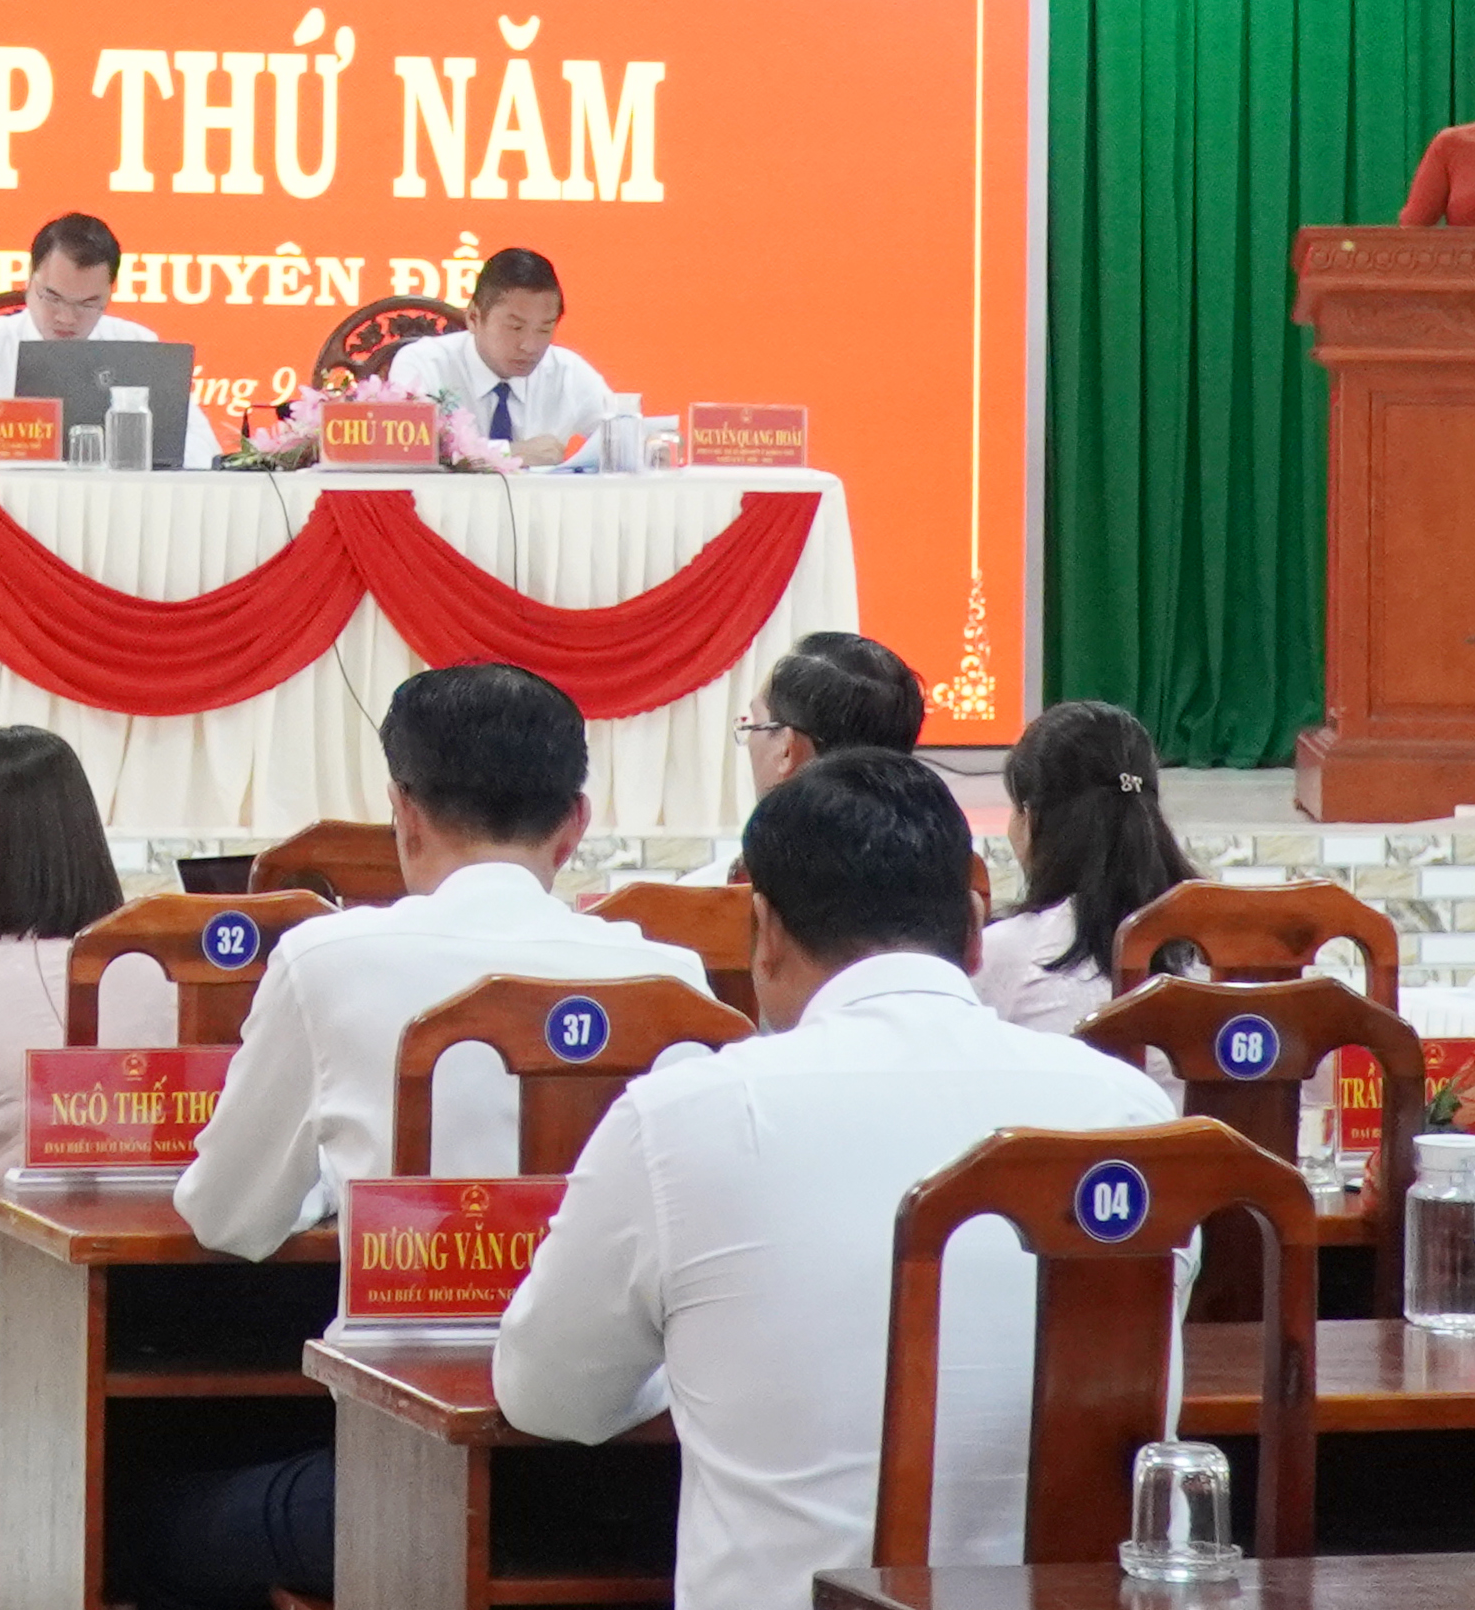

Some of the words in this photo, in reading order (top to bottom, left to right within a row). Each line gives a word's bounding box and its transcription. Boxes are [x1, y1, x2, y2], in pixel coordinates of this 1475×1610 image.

[91, 7, 358, 199] THỨ
[392, 13, 666, 206] NĂM
[114, 242, 364, 306] HUYÊN
[191, 365, 258, 418] áng
[270, 366, 297, 407] 9
[326, 411, 377, 446] CHỦ
[382, 420, 431, 452] TỌA
[216, 926, 246, 956] 32
[562, 1014, 592, 1045] 37
[1231, 1032, 1263, 1063] 68
[52, 1081, 108, 1125] NGÔ
[114, 1075, 167, 1125] THẾ
[1341, 1061, 1383, 1109] TRẦ
[1094, 1182, 1130, 1220] 04
[362, 1226, 449, 1271] DƯƠNG
[453, 1221, 505, 1270] VĂN
